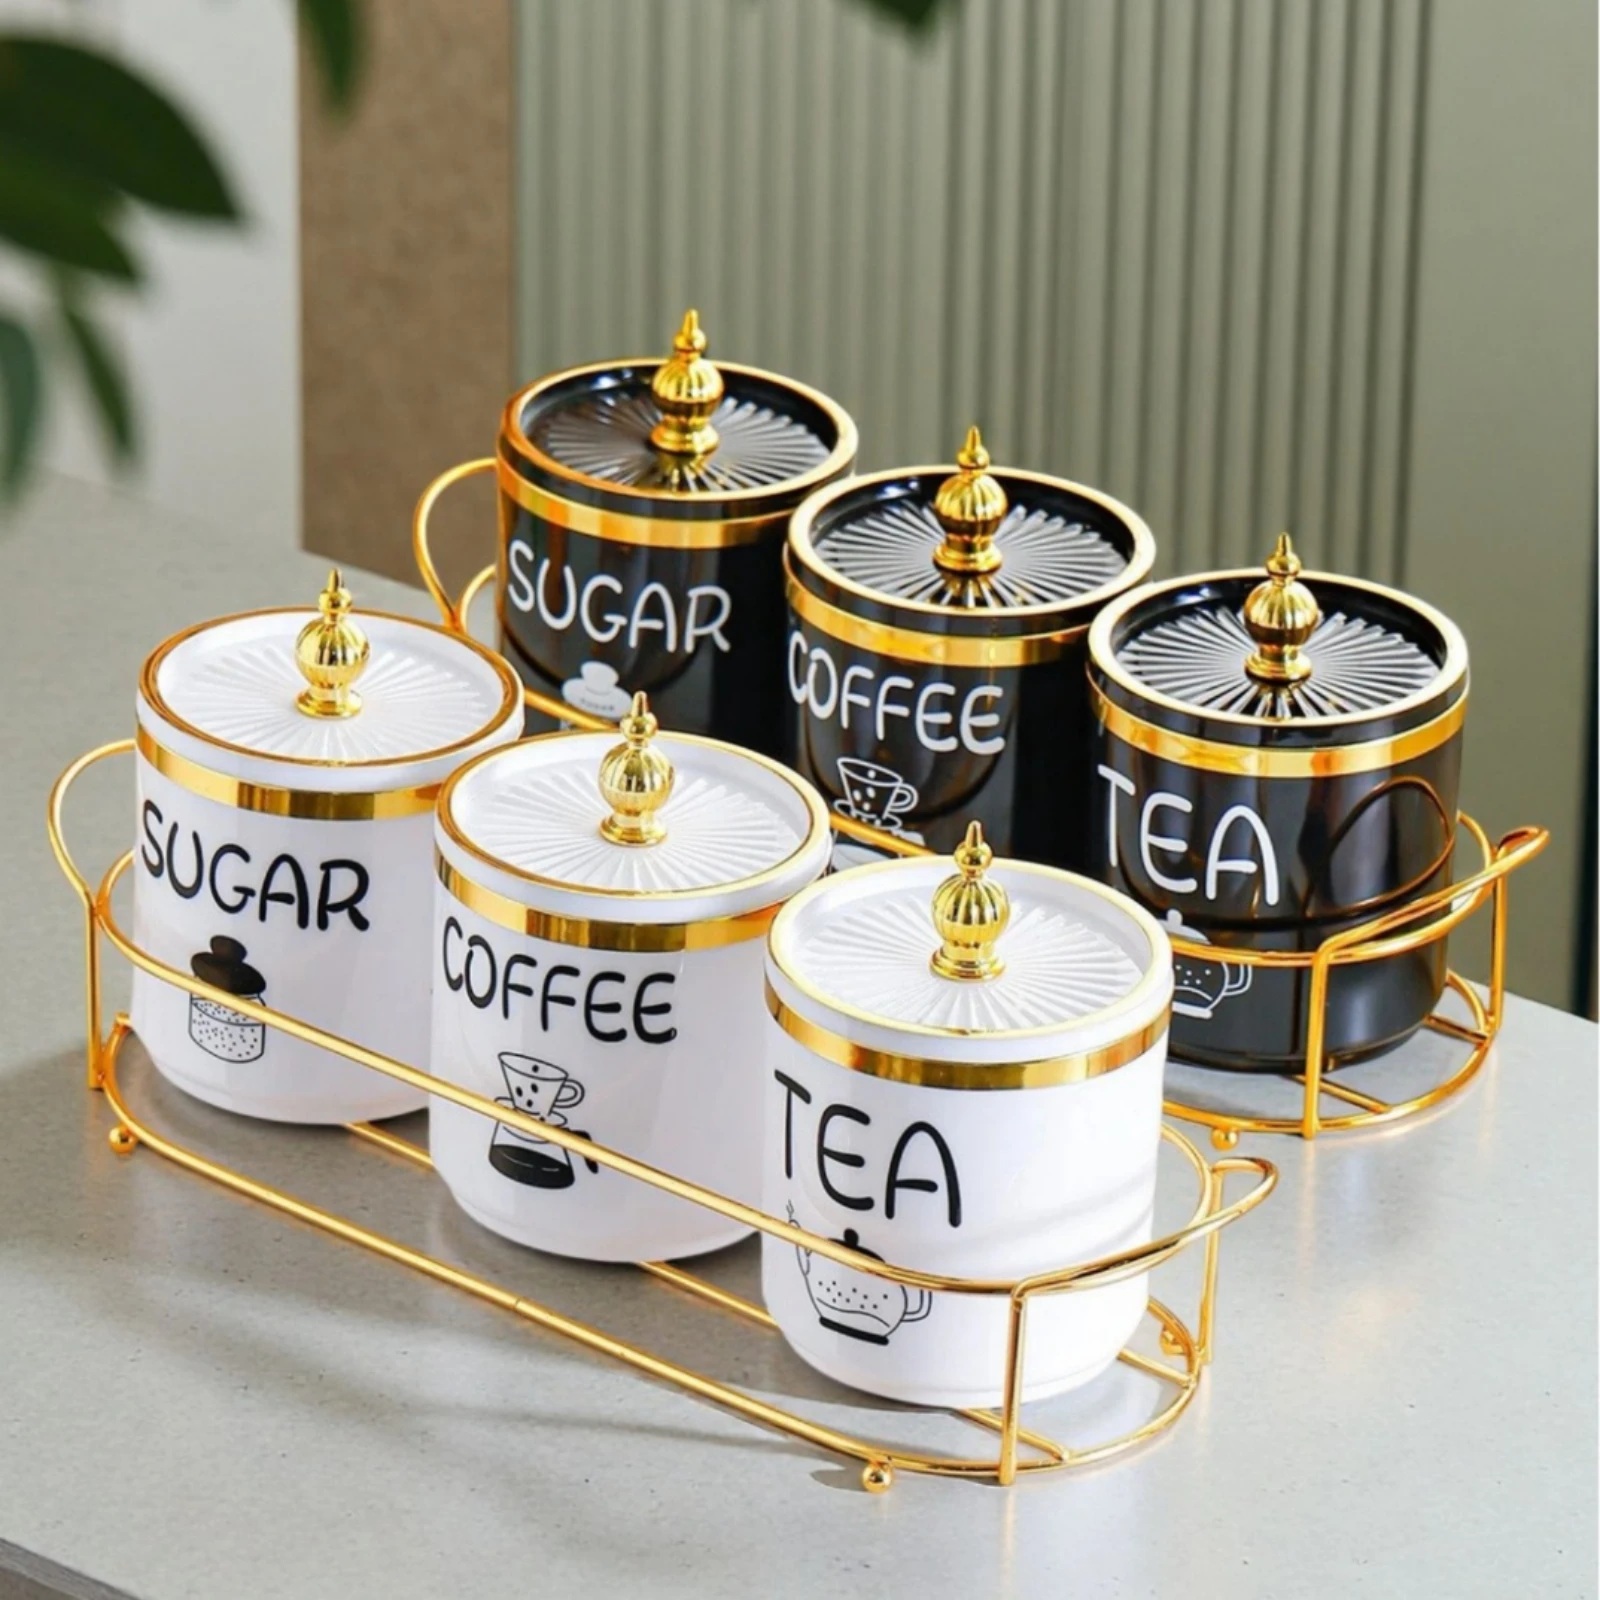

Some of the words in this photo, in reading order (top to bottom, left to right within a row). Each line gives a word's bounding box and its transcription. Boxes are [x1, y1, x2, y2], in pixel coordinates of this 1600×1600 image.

[507, 539, 731, 653] SUGAR
[787, 630, 1006, 755] COFFEE
[141, 799, 370, 932] SUGAR
[1098, 764, 1280, 906] TEA
[442, 916, 677, 1044] COFFEE
[774, 1069, 962, 1228] TEA
